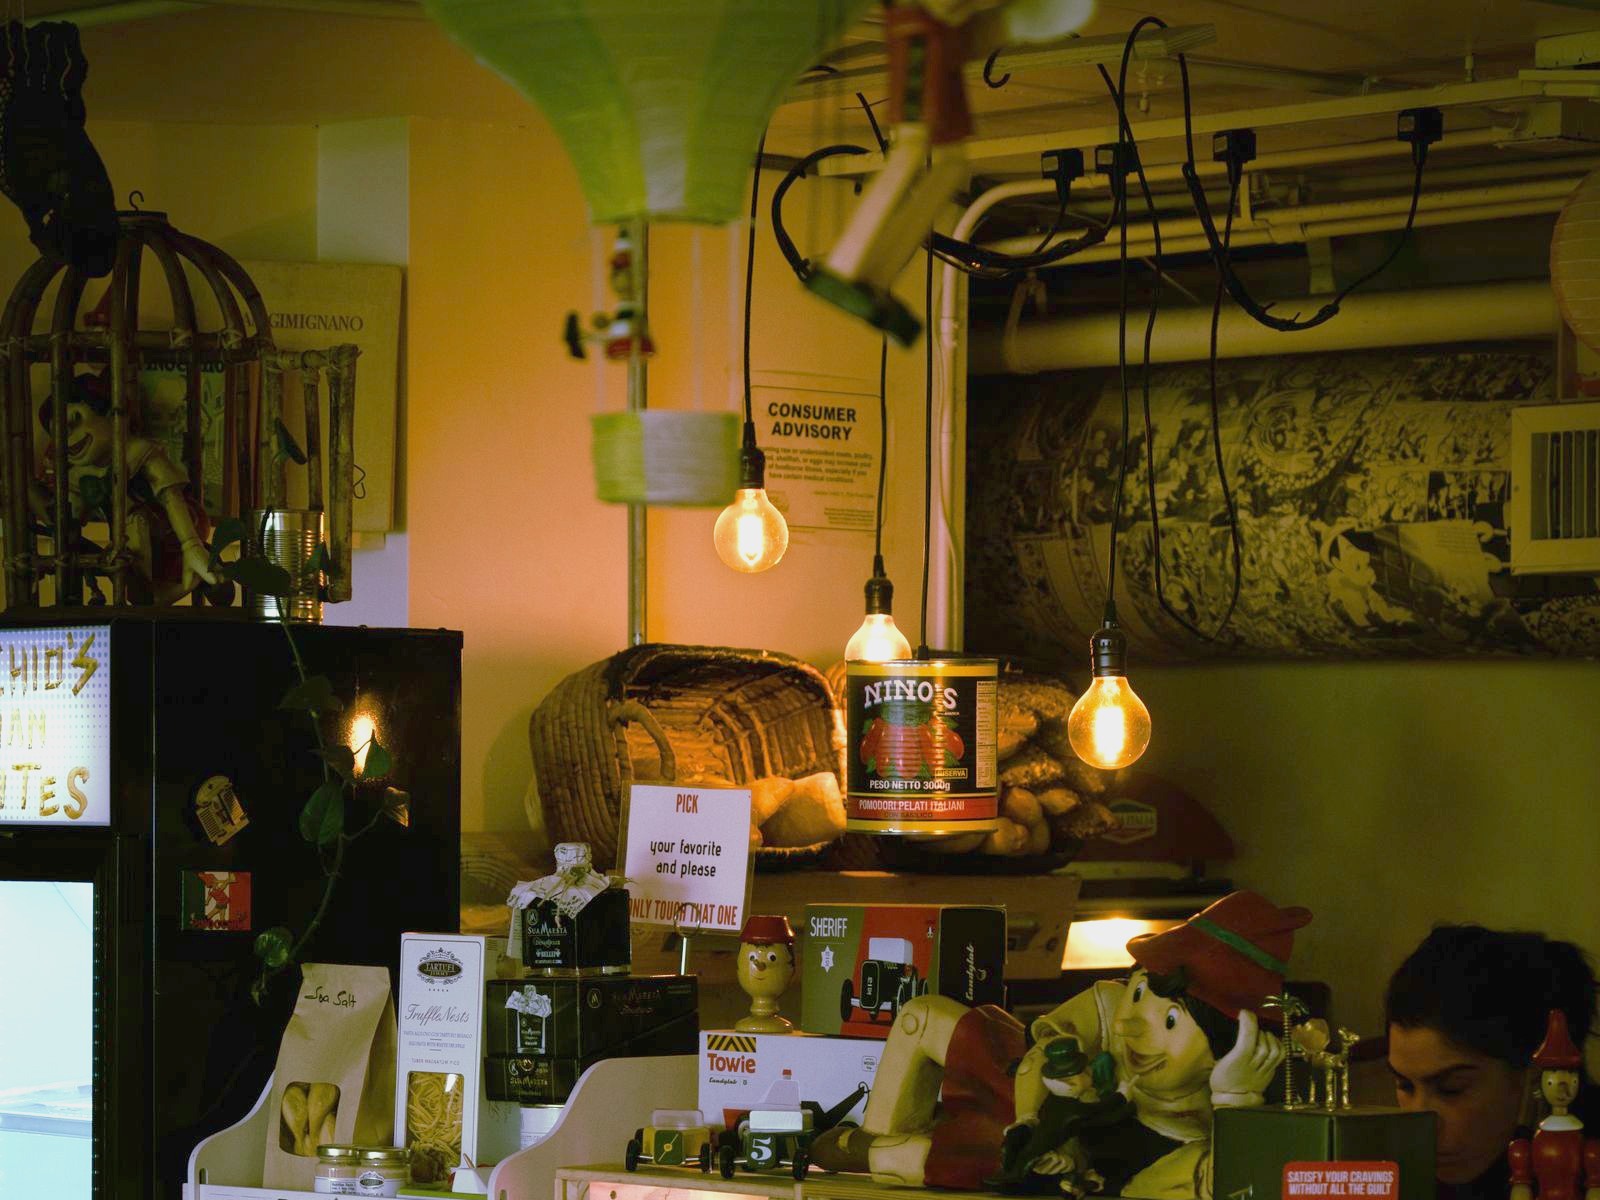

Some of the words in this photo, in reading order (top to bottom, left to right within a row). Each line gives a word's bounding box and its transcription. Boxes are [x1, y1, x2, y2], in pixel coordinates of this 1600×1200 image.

[767, 402, 857, 423] CONSUMER
[771, 421, 853, 441] ADVISORY
[0, 707, 46, 749] AN
[869, 780, 890, 790] PESO
[892, 780, 921, 790] NETTO
[676, 793, 699, 814] PICK
[859, 800, 898, 811] POMODORI
[899, 800, 928, 811] PELATI
[930, 800, 965, 811] ITALIANI
[650, 840, 676, 856] your
[680, 839, 722, 857] favorite
[656, 860, 677, 875] and
[680, 861, 716, 878] please
[717, 905, 738, 926] ONE
[810, 916, 848, 938] SHERIFF
[332, 990, 357, 1008] Salt
[404, 1003, 441, 1026] Truffle
[442, 1006, 470, 1023] Nests
[707, 1053, 756, 1074] Towie
[750, 1137, 773, 1160] 5
[1287, 1171, 1323, 1183] SATISFY
[1325, 1171, 1349, 1183] YOUR
[1350, 1171, 1394, 1183] CRAVINGS
[1288, 1183, 1328, 1195] WITHOUT
[1329, 1183, 1347, 1195] ALL
[1348, 1183, 1365, 1195] THE
[1367, 1183, 1392, 1196] GUILT
